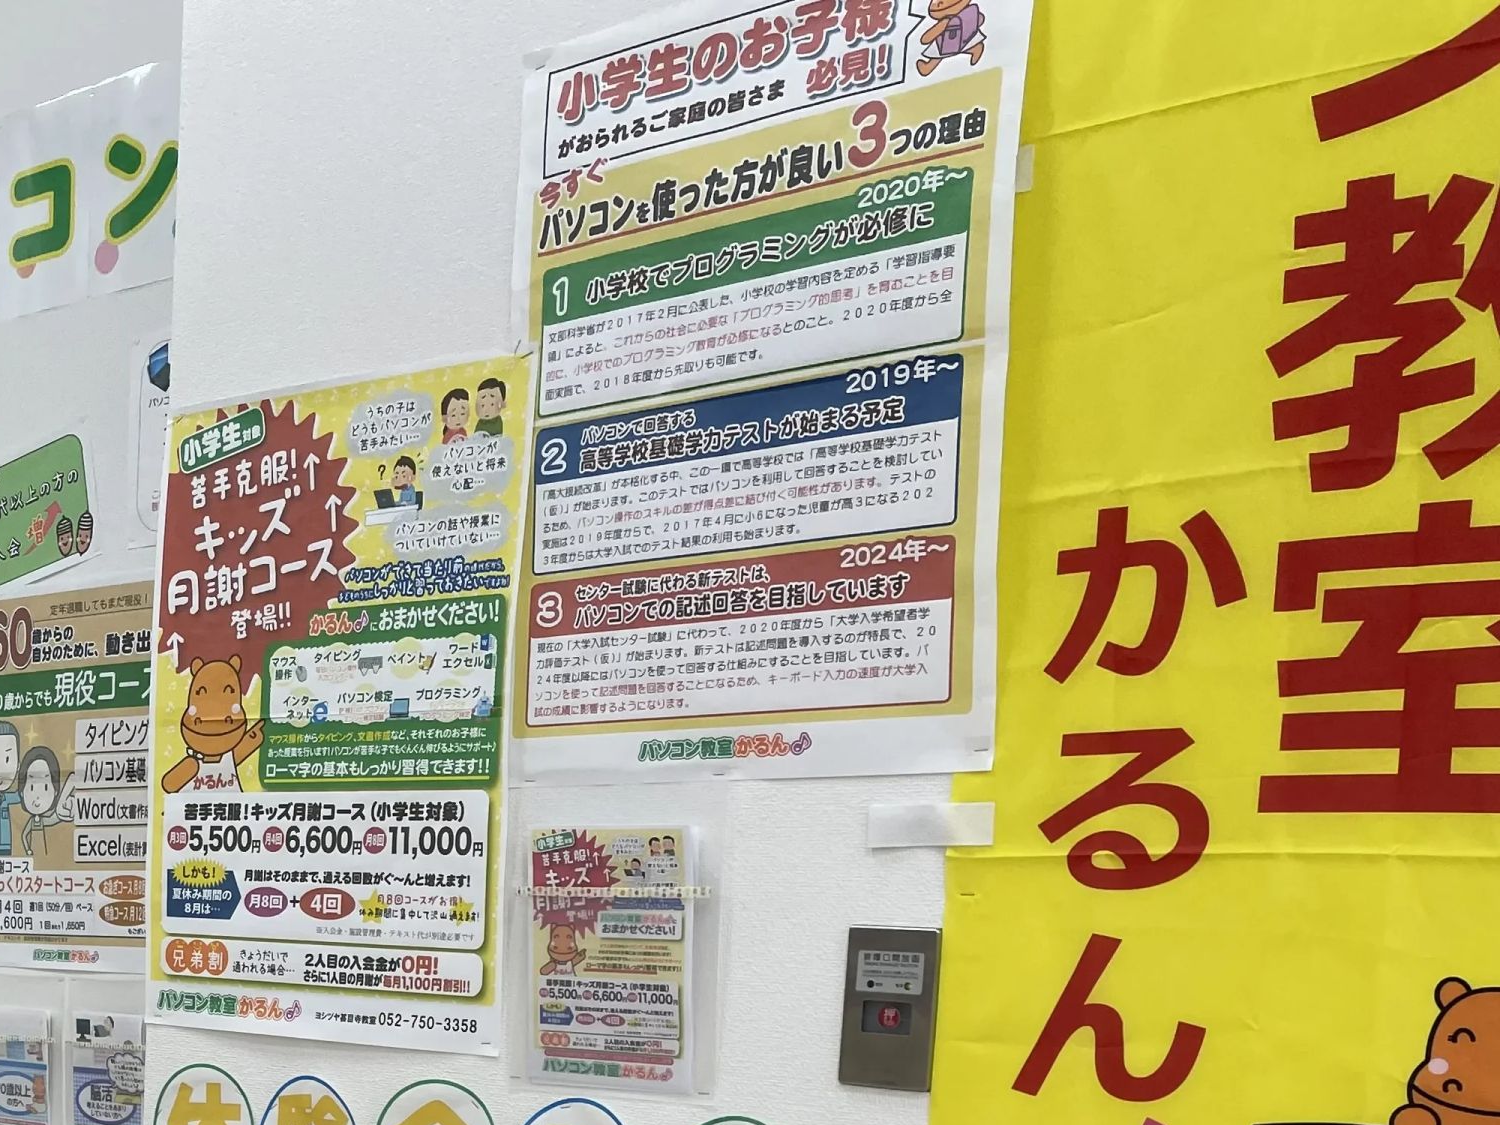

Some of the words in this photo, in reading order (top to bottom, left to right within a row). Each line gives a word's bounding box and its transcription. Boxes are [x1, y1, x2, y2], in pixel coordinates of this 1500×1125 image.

[806, 44, 889, 97] 必見!
[558, 80, 785, 160] がおられるご家庭の皆さま
[540, 157, 607, 207] 今すぐ
[586, 201, 933, 306] 小学校でプログラミングが必修に
[579, 397, 904, 474] 高等学校基礎学力テストが始まる予定
[581, 409, 696, 447] パソコンで回答する
[194, 487, 301, 560] キッズ
[167, 538, 338, 616] 月謝コース
[574, 572, 910, 629] パソコンでの記述回答を目指しています
[314, 649, 362, 663] タイピング
[449, 643, 478, 654] ワード
[378, 1012, 478, 1034] 052-750-3358
